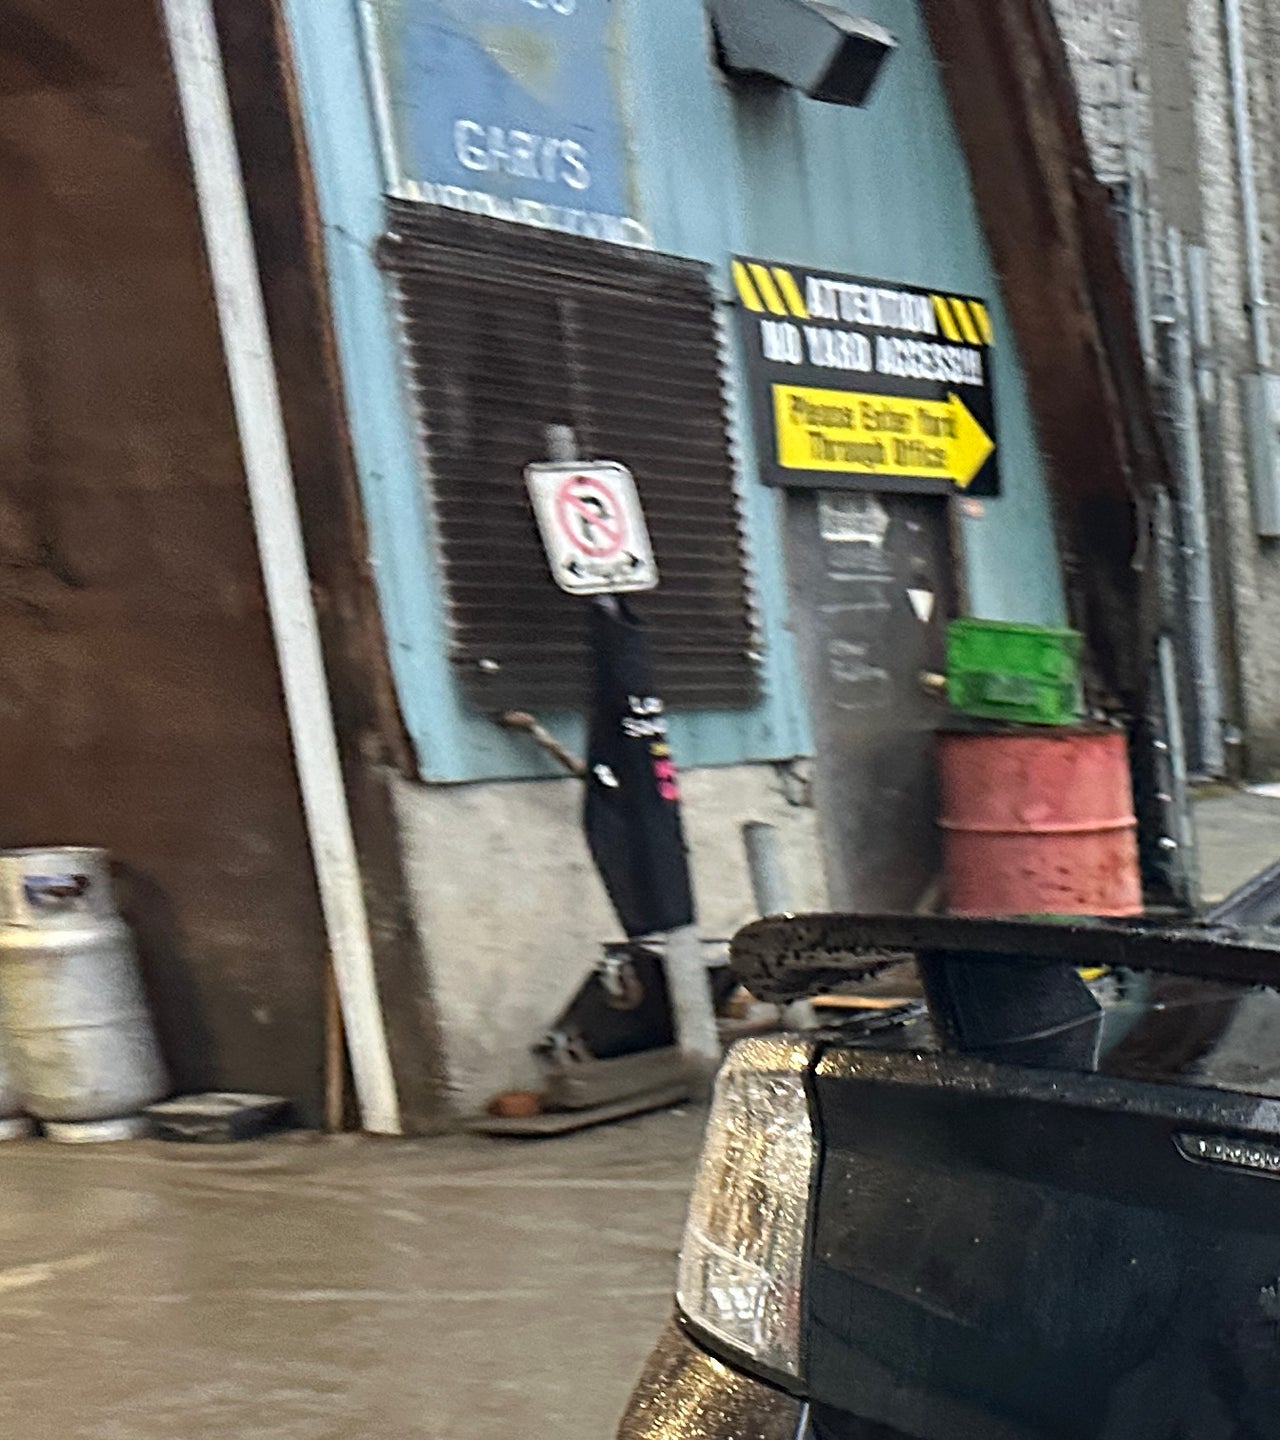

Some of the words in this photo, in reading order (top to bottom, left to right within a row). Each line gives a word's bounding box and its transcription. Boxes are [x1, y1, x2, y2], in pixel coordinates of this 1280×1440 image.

[804, 275, 938, 335] ATTENTION
[760, 320, 803, 365] NO
[803, 325, 872, 372] YARD
[788, 394, 855, 430] Please
[858, 401, 911, 434] Enter
[808, 431, 887, 469] Through
[893, 437, 947, 468] Office
